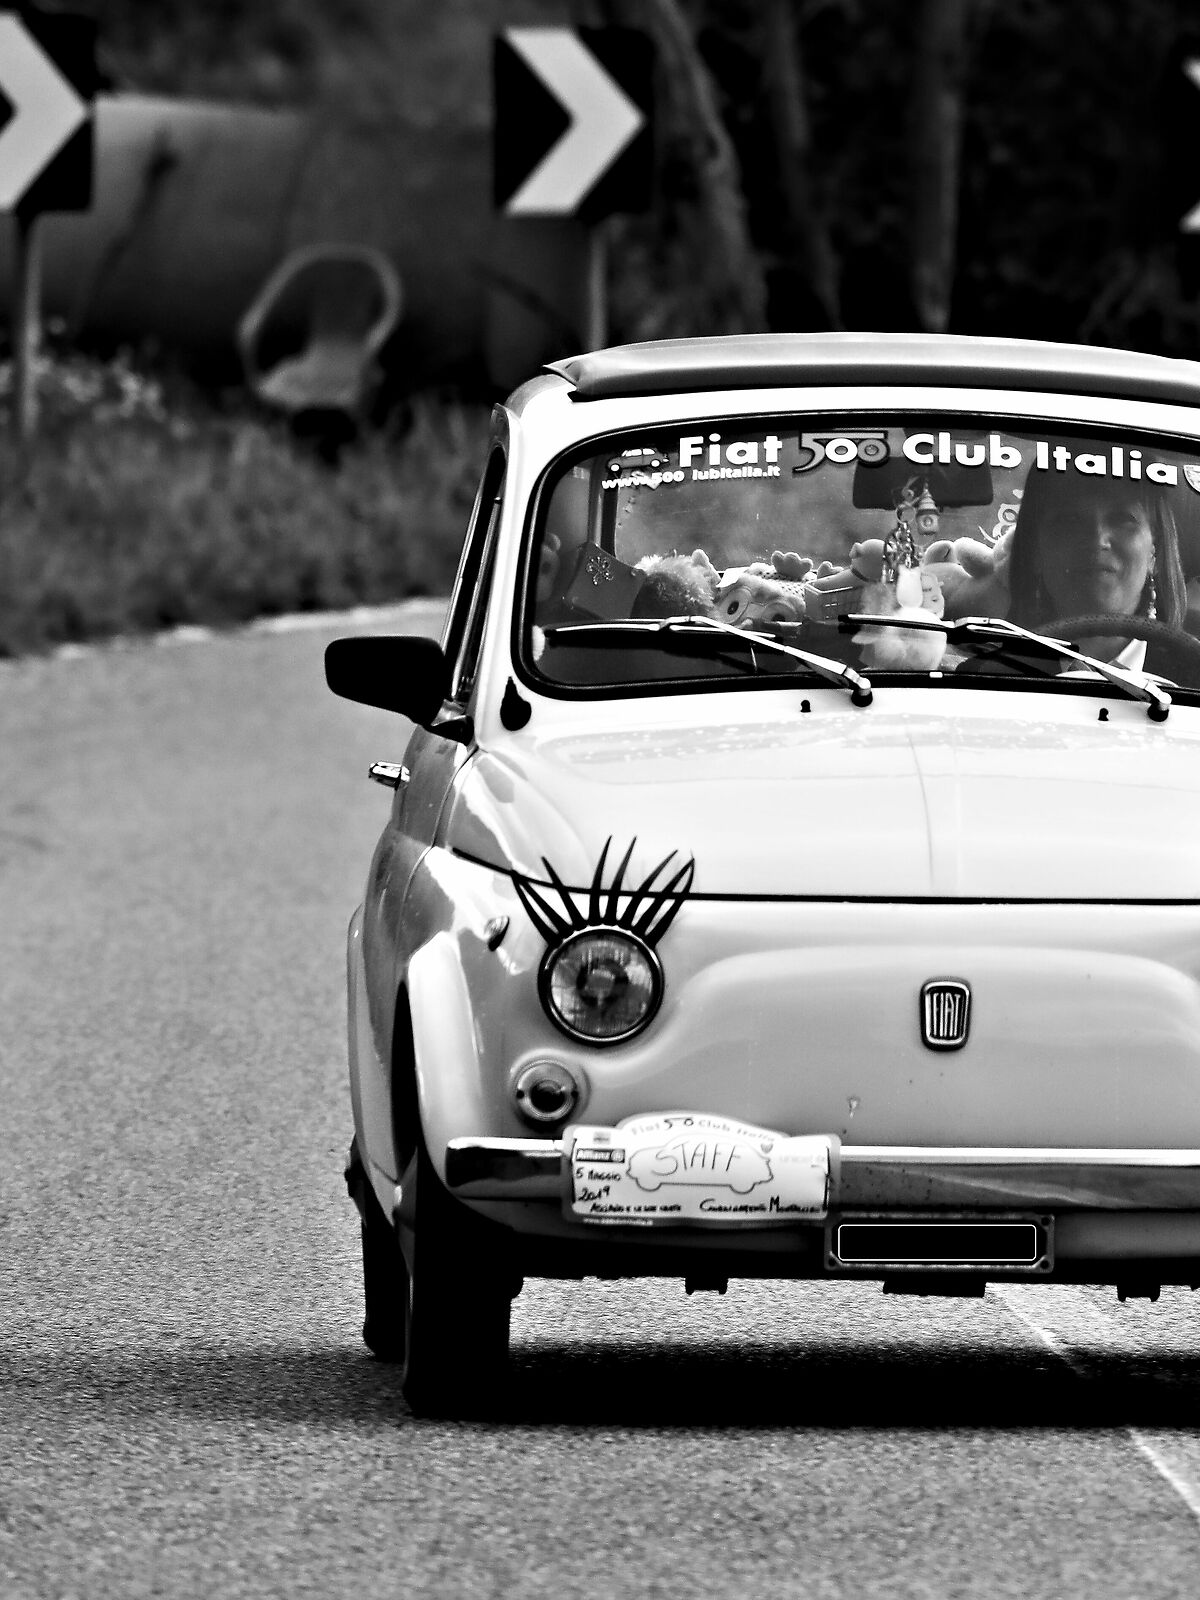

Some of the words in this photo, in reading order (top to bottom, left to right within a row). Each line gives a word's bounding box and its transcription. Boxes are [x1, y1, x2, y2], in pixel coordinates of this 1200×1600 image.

[680, 433, 782, 467] Fiat
[793, 432, 888, 472] 500
[902, 432, 1022, 468] Club
[1036, 441, 1178, 486] Italia
[932, 992, 961, 1037] FIAT
[698, 1119, 731, 1133] Club
[651, 1140, 743, 1176] STAFF
[575, 1167, 585, 1179] 5
[578, 1186, 611, 1201] 2019
